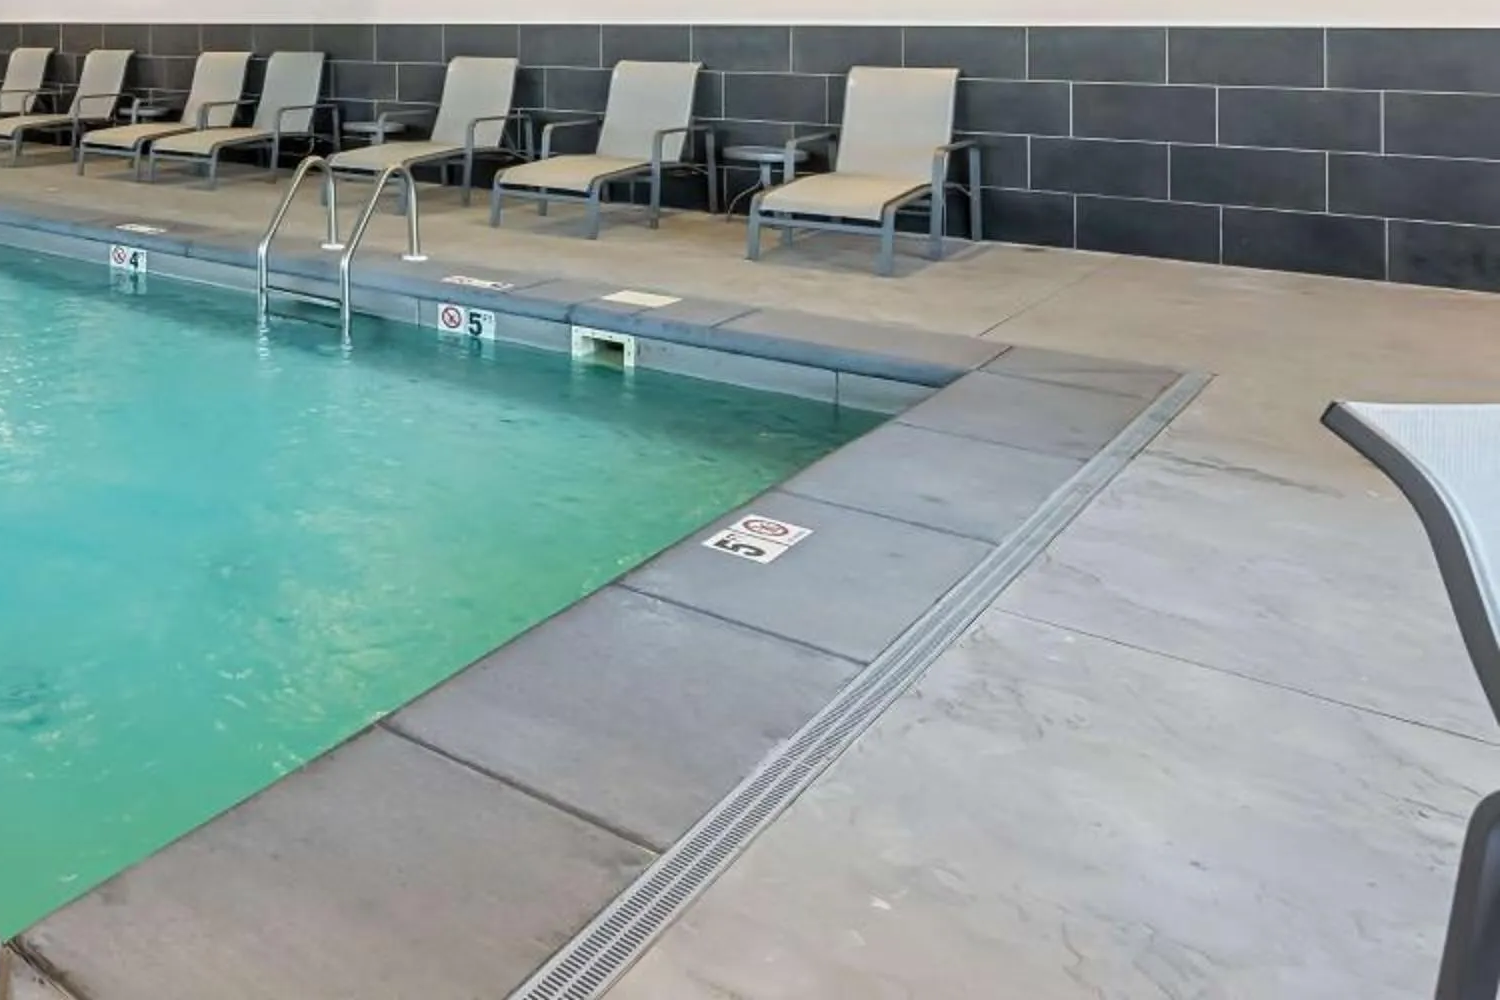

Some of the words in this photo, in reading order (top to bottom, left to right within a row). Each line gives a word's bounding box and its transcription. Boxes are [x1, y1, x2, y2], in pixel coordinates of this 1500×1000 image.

[129, 251, 139, 268] 4
[468, 311, 483, 336] 5
[713, 540, 766, 556] 5
